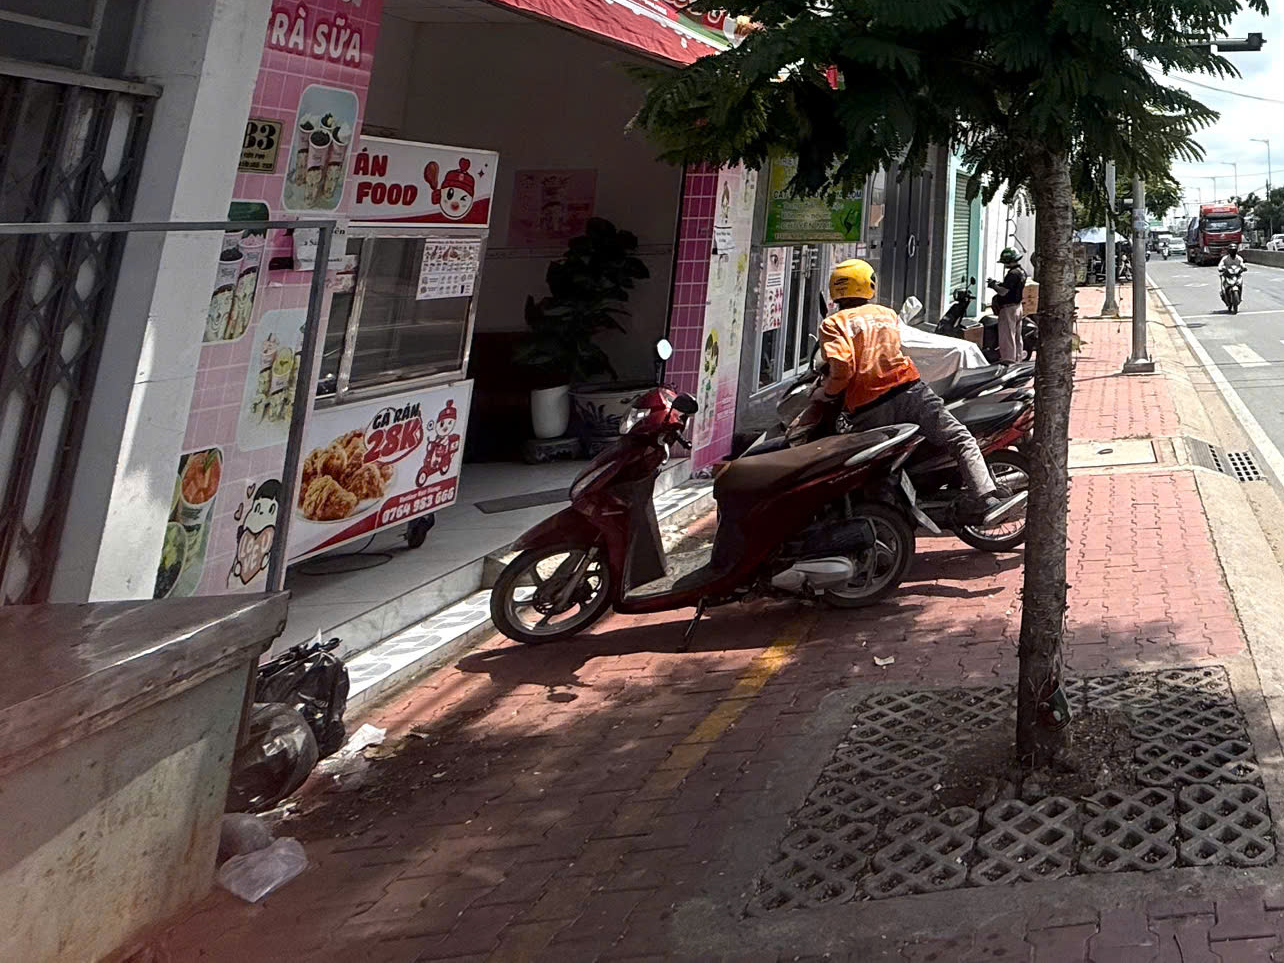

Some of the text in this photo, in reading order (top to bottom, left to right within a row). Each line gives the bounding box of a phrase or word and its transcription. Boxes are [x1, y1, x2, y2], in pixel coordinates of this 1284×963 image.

[269, 6, 361, 63] RÀ SỮA
[356, 181, 418, 206] FOOD
[372, 402, 421, 430] GÀ RÁN
[363, 417, 421, 465] 28K
